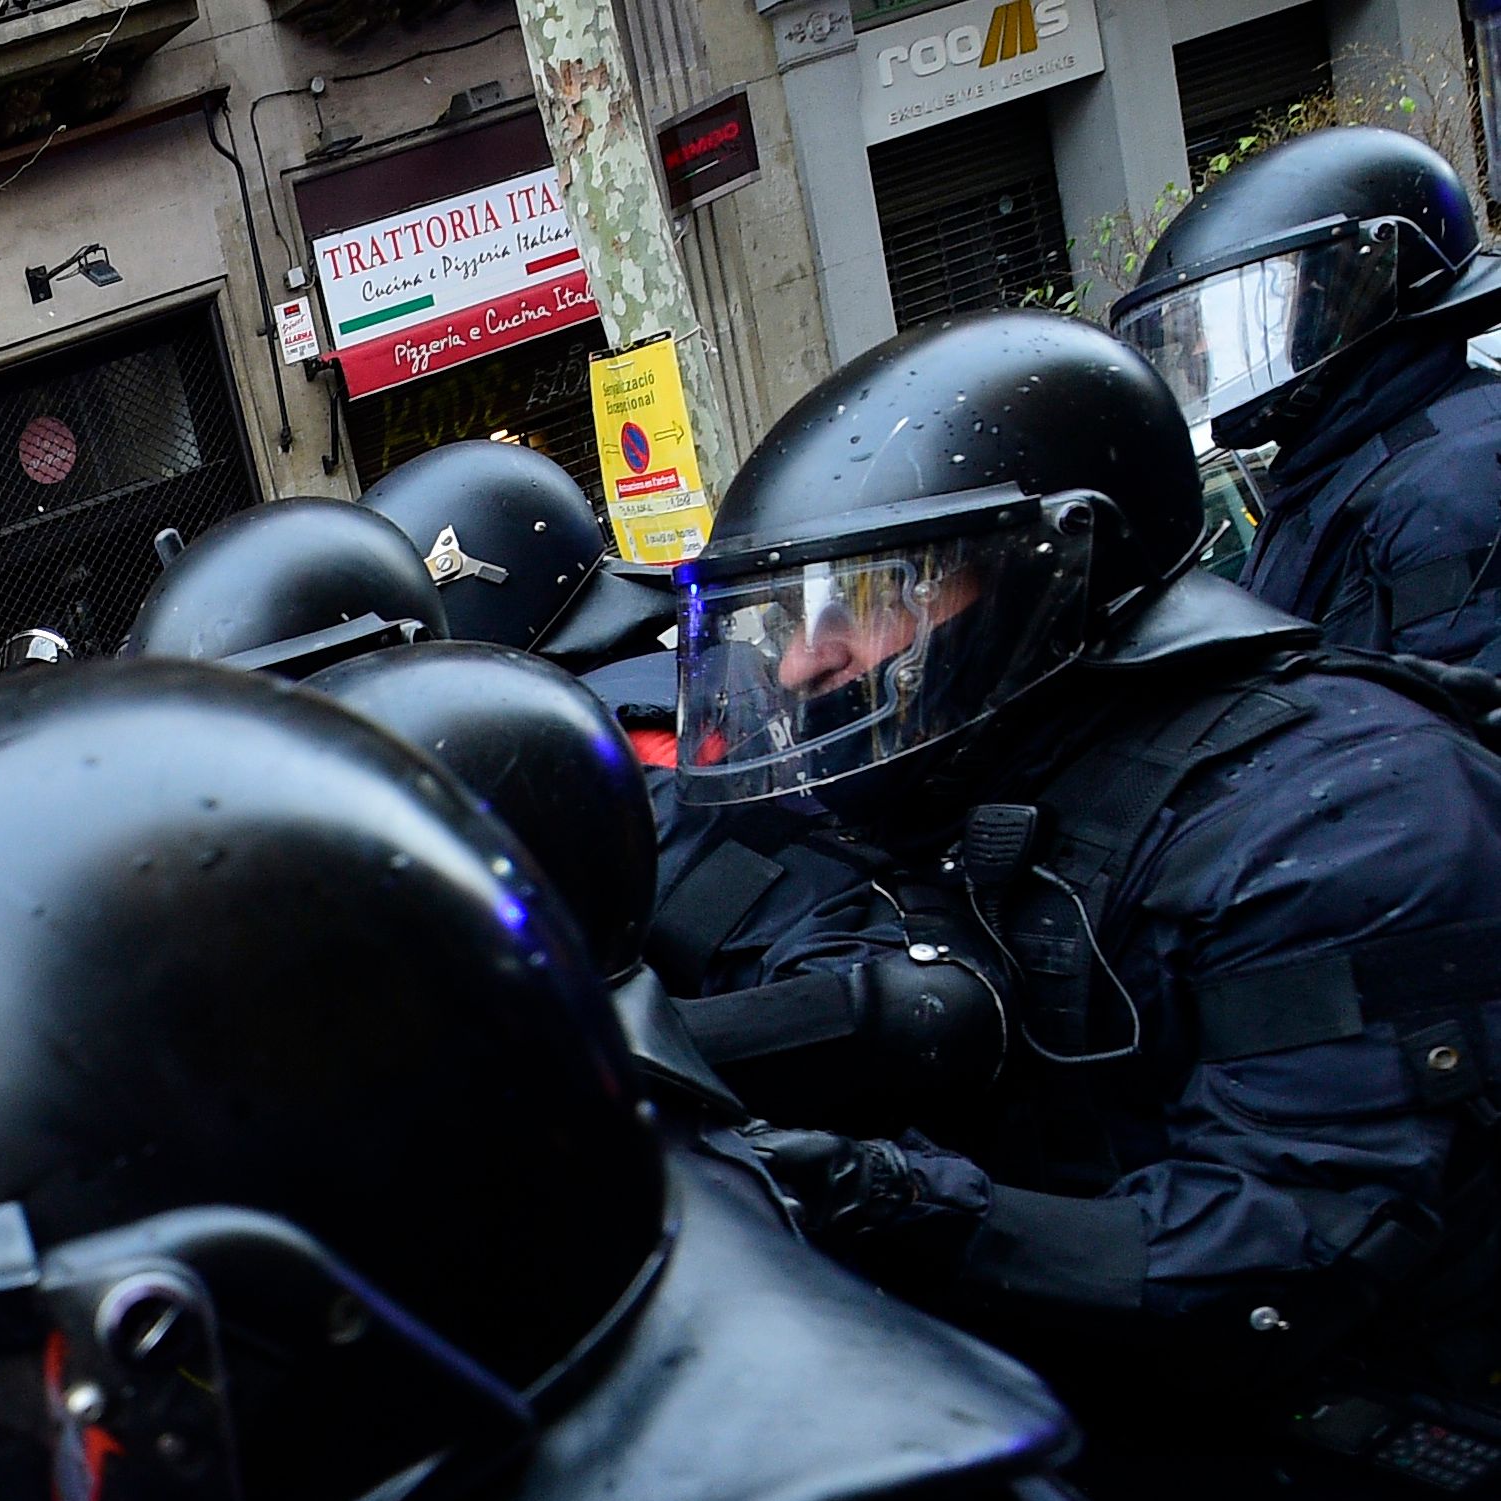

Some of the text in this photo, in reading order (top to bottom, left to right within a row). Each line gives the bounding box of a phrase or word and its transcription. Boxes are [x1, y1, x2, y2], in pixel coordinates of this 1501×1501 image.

[323, 178, 565, 281] TRATTORIA ITA
[361, 270, 423, 302] Cucina
[429, 268, 437, 281] e
[442, 243, 511, 281] Pizzeria
[394, 327, 466, 374] Pizzeria
[469, 325, 482, 341] e
[484, 301, 552, 335] Cucina
